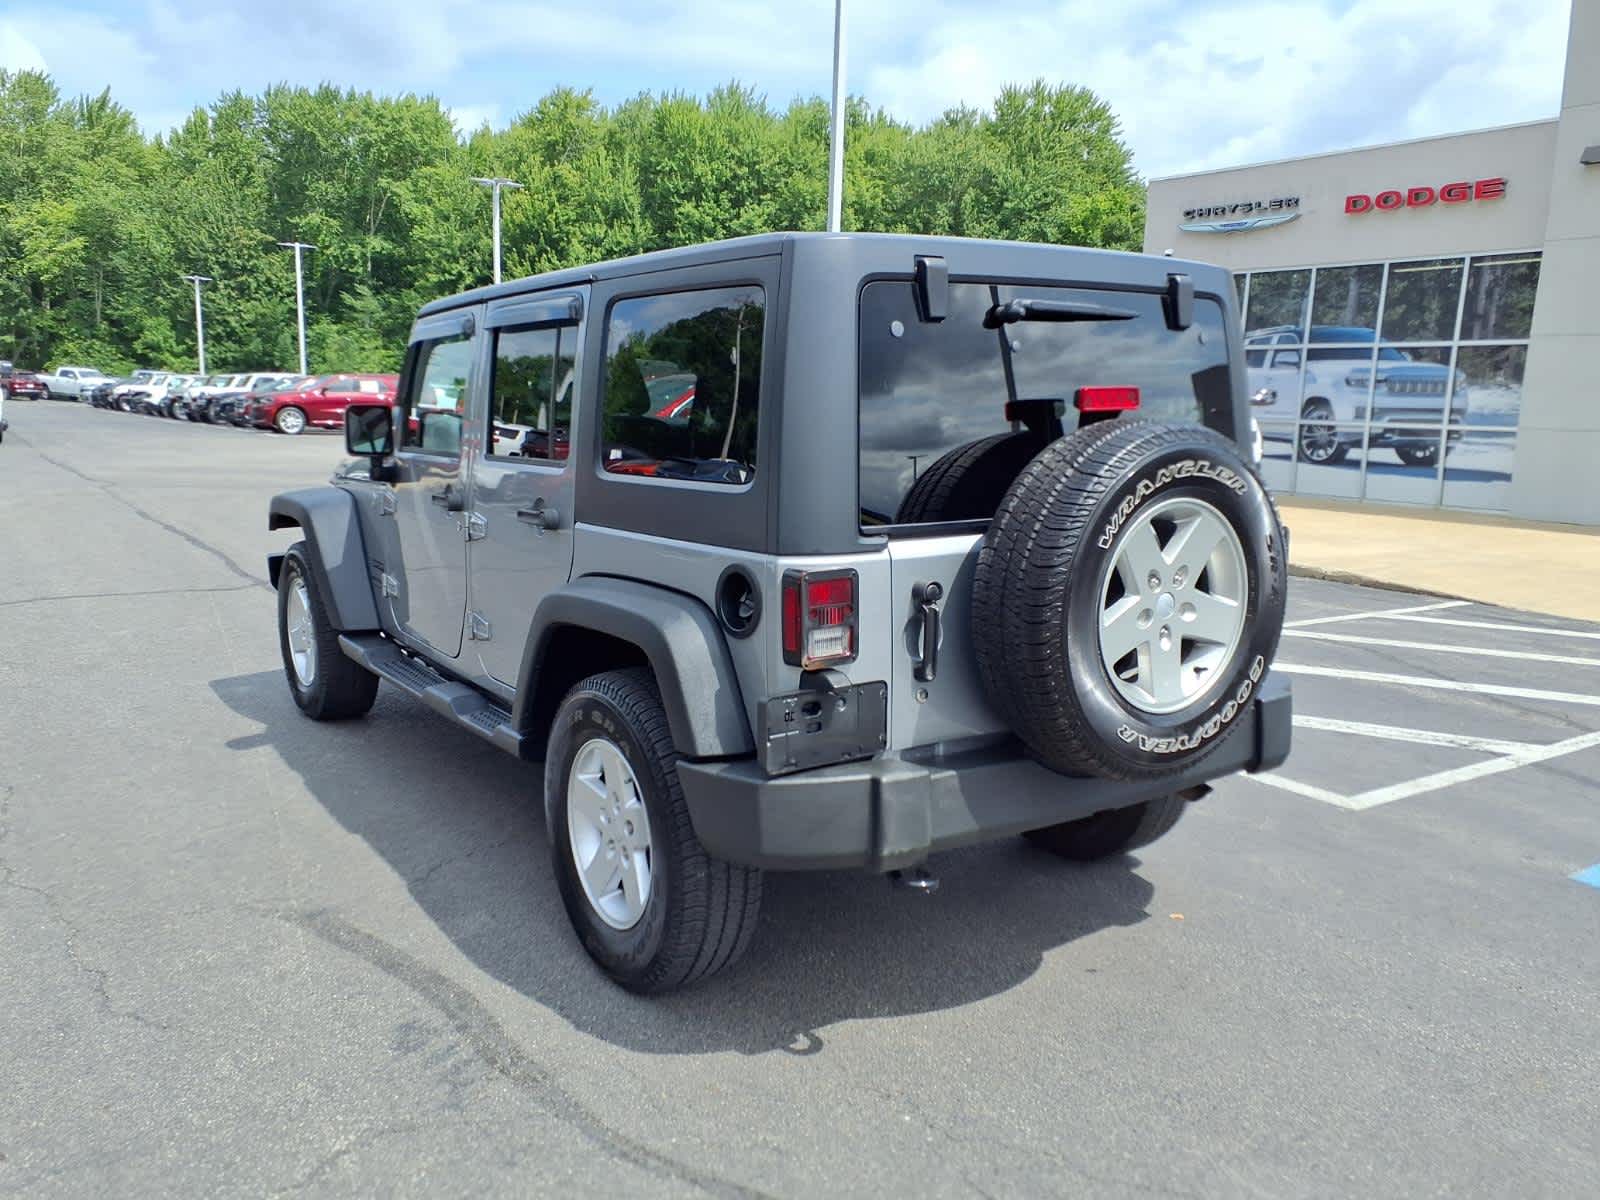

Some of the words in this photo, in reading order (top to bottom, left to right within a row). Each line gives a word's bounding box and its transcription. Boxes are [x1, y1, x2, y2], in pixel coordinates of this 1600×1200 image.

[1183, 197, 1300, 219] CHRYSLER
[1344, 177, 1507, 214] DODGE
[1097, 459, 1249, 550] WRANGLER
[1116, 655, 1264, 753] GOODYEAR
